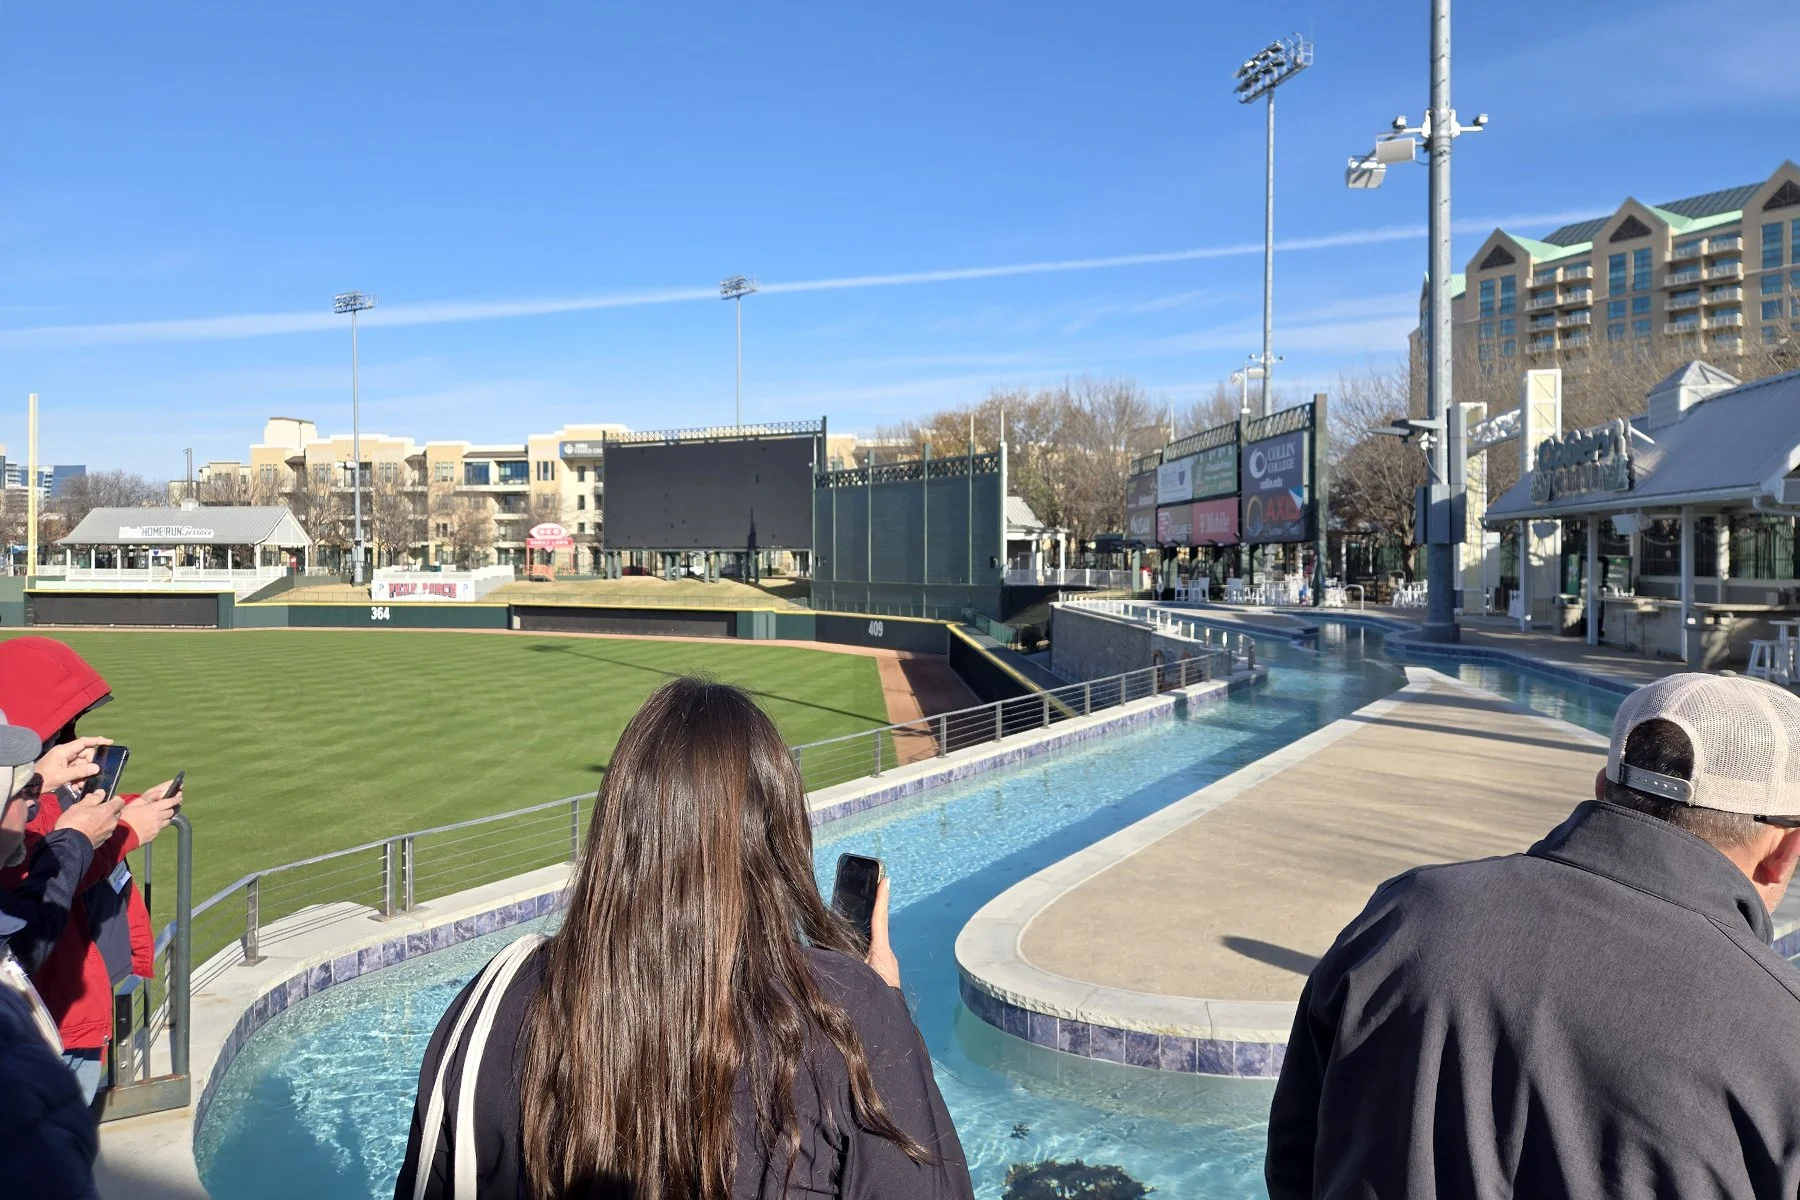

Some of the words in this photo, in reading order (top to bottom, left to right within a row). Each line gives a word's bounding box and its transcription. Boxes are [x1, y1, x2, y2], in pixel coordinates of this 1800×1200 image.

[1267, 442, 1296, 461] COLLIN
[1267, 459, 1296, 473] COLLEGE
[141, 526, 164, 537] HOME
[165, 526, 182, 537] RUN
[371, 607, 391, 620] 364
[868, 621, 884, 637] 409
